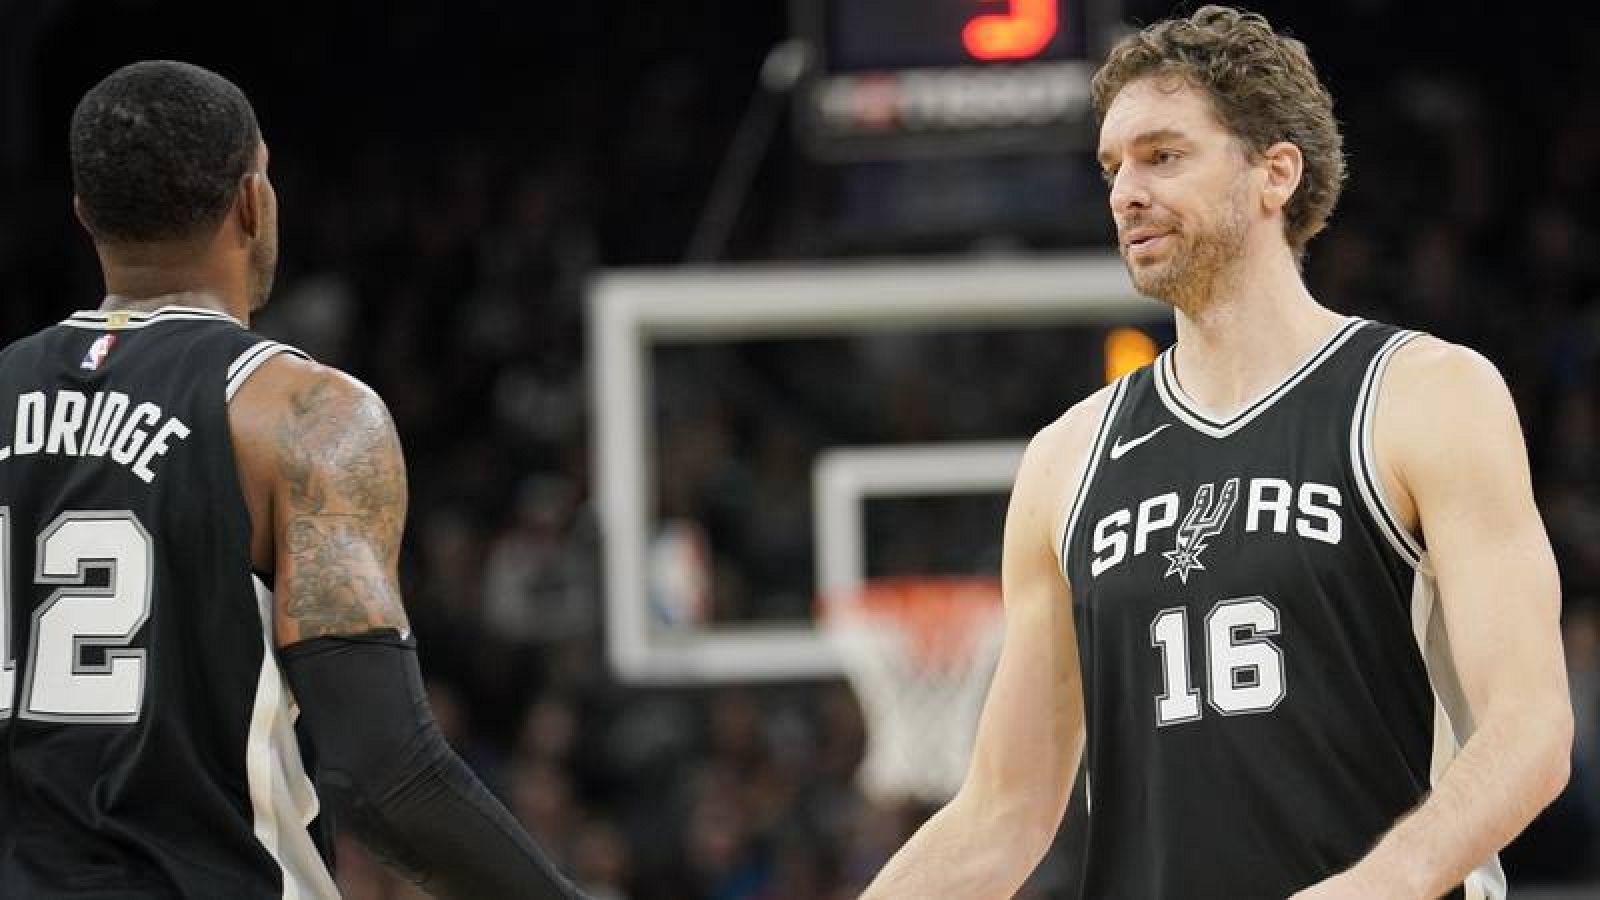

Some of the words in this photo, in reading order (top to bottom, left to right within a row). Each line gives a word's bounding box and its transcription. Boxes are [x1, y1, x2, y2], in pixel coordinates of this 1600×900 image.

[0, 390, 191, 483] DRIDGE
[1091, 477, 1343, 584] SPURS
[0, 506, 153, 723] 2
[1151, 596, 1286, 726] 16
